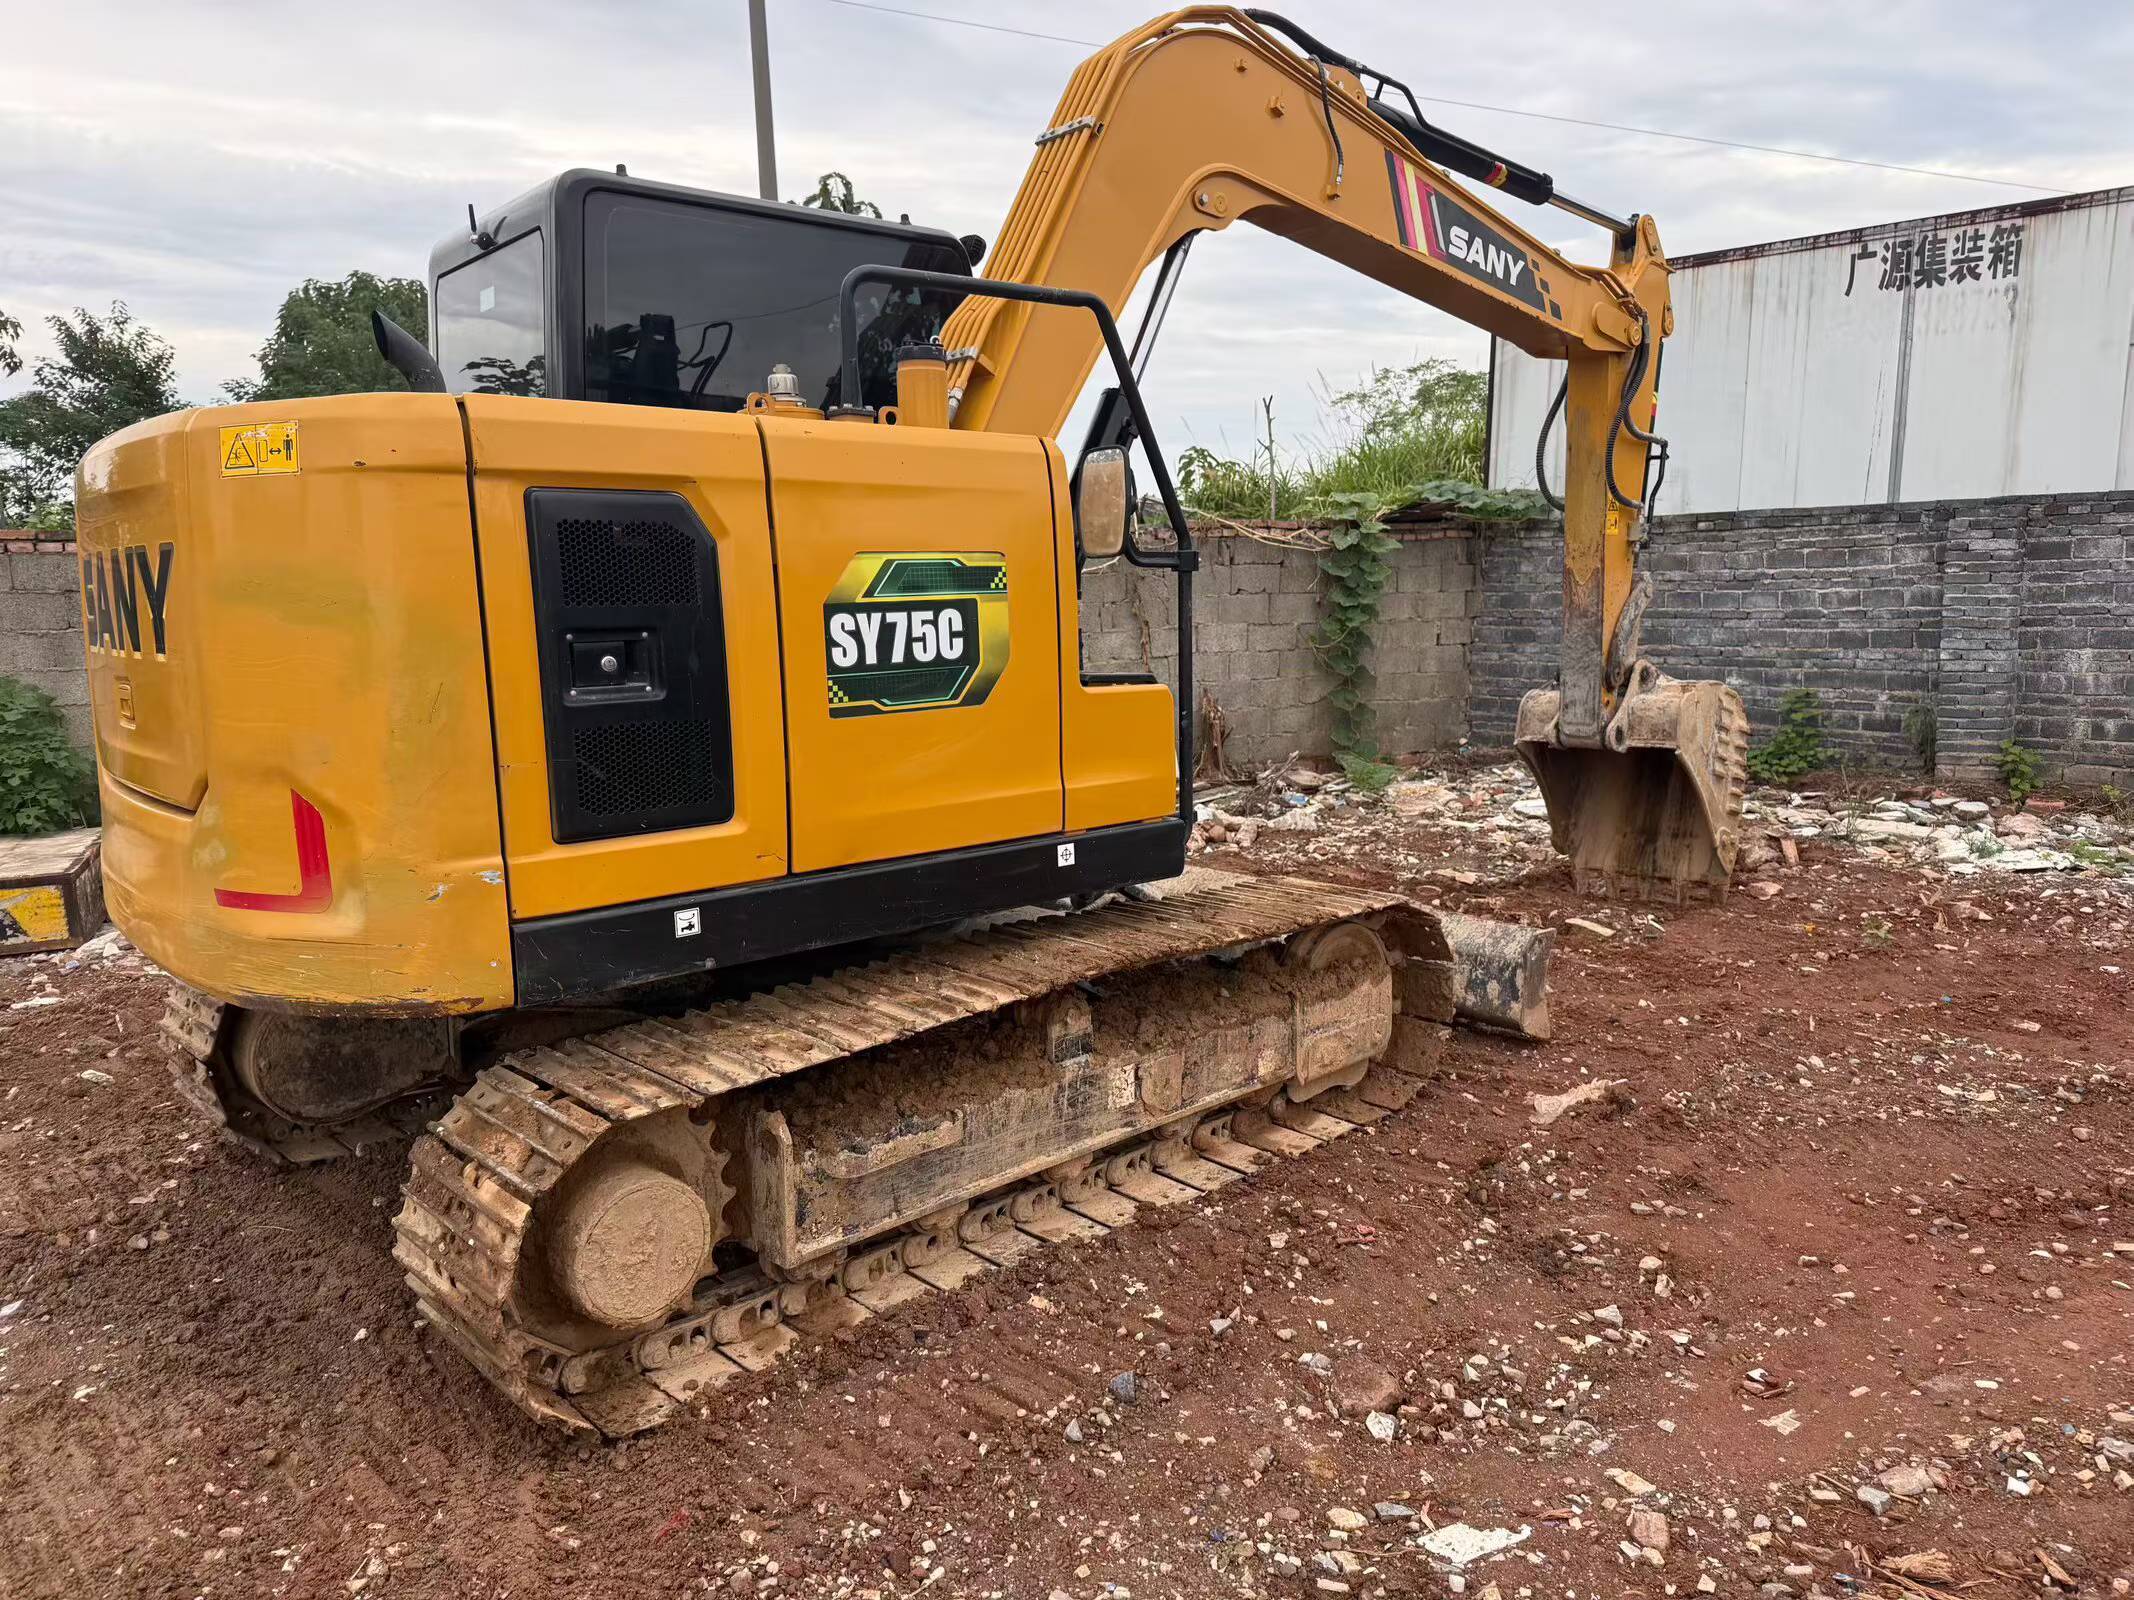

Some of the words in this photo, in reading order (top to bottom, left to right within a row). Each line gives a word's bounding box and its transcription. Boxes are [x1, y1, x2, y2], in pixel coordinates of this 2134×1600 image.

[1448, 225, 1525, 286] SANY
[1844, 223, 2025, 297] 广源集装箱
[829, 608, 964, 667] SY75C
